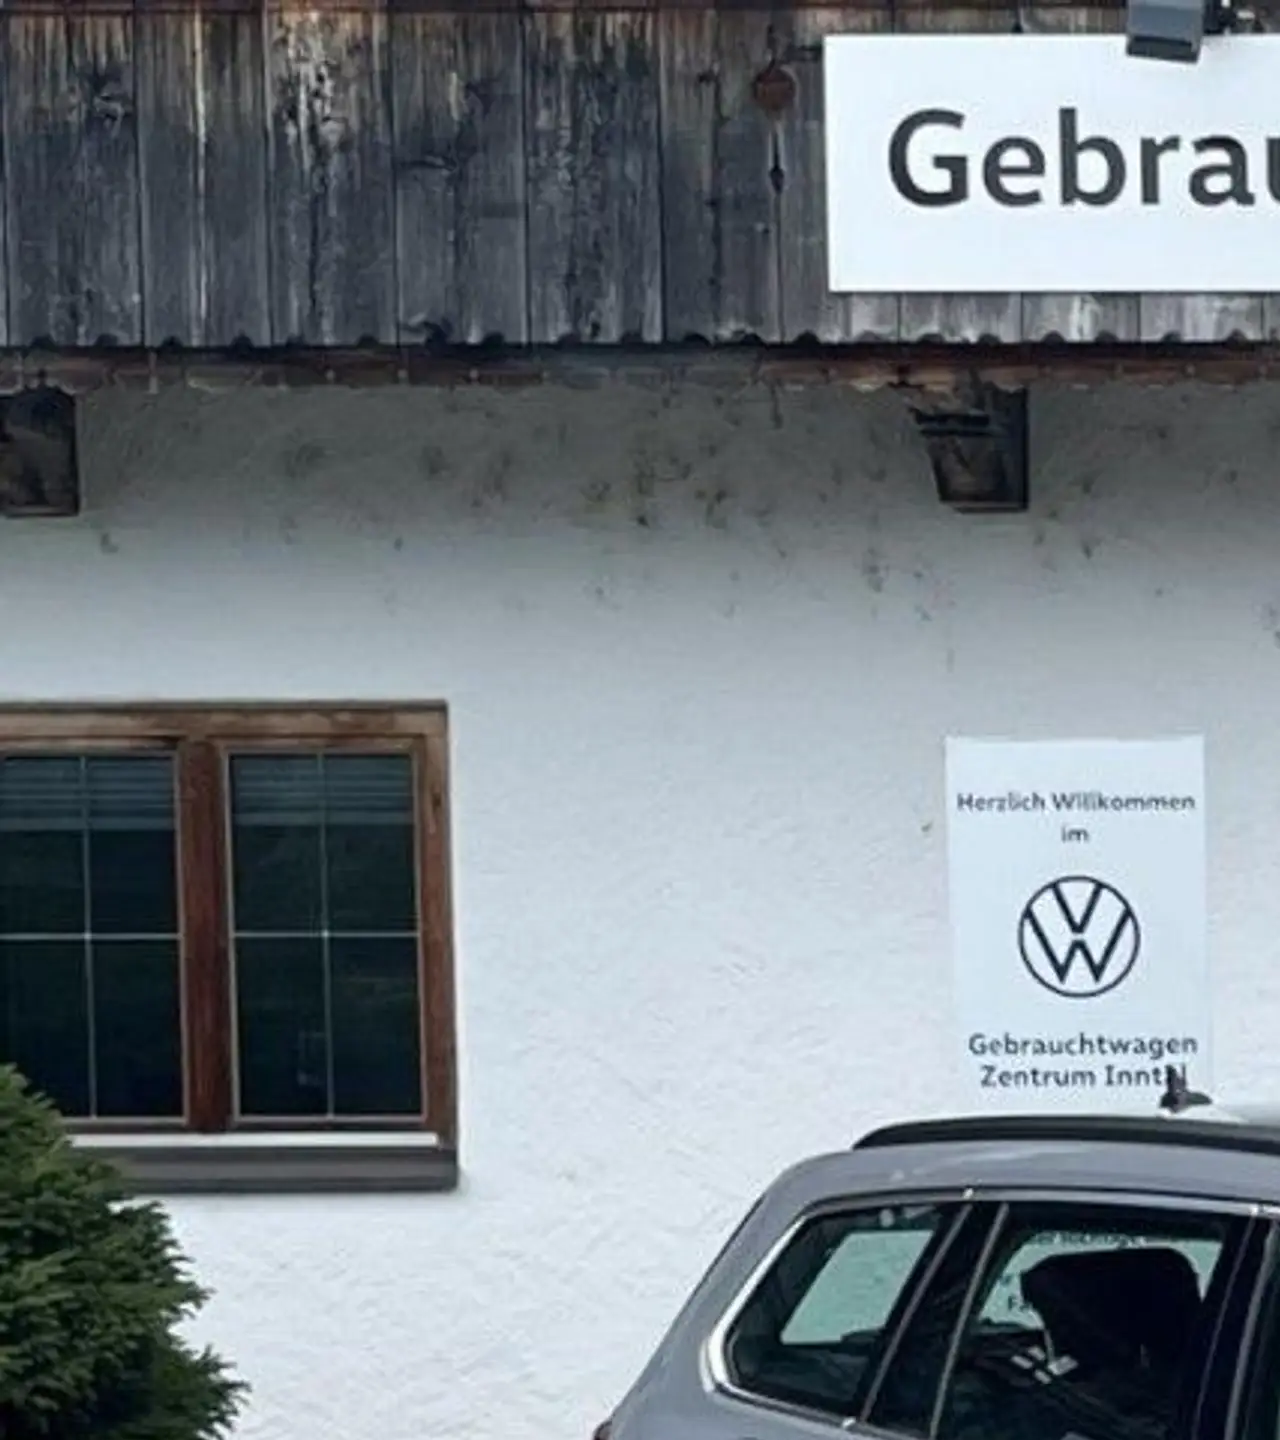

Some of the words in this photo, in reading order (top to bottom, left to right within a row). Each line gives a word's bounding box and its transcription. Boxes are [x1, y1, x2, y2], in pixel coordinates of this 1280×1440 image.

[956, 791, 1046, 813] Herzlich
[1051, 790, 1197, 812] Willkommen
[1060, 825, 1091, 843] im
[967, 1031, 1199, 1061] Gebrauchtwagen
[980, 1064, 1097, 1088] Zentrum
